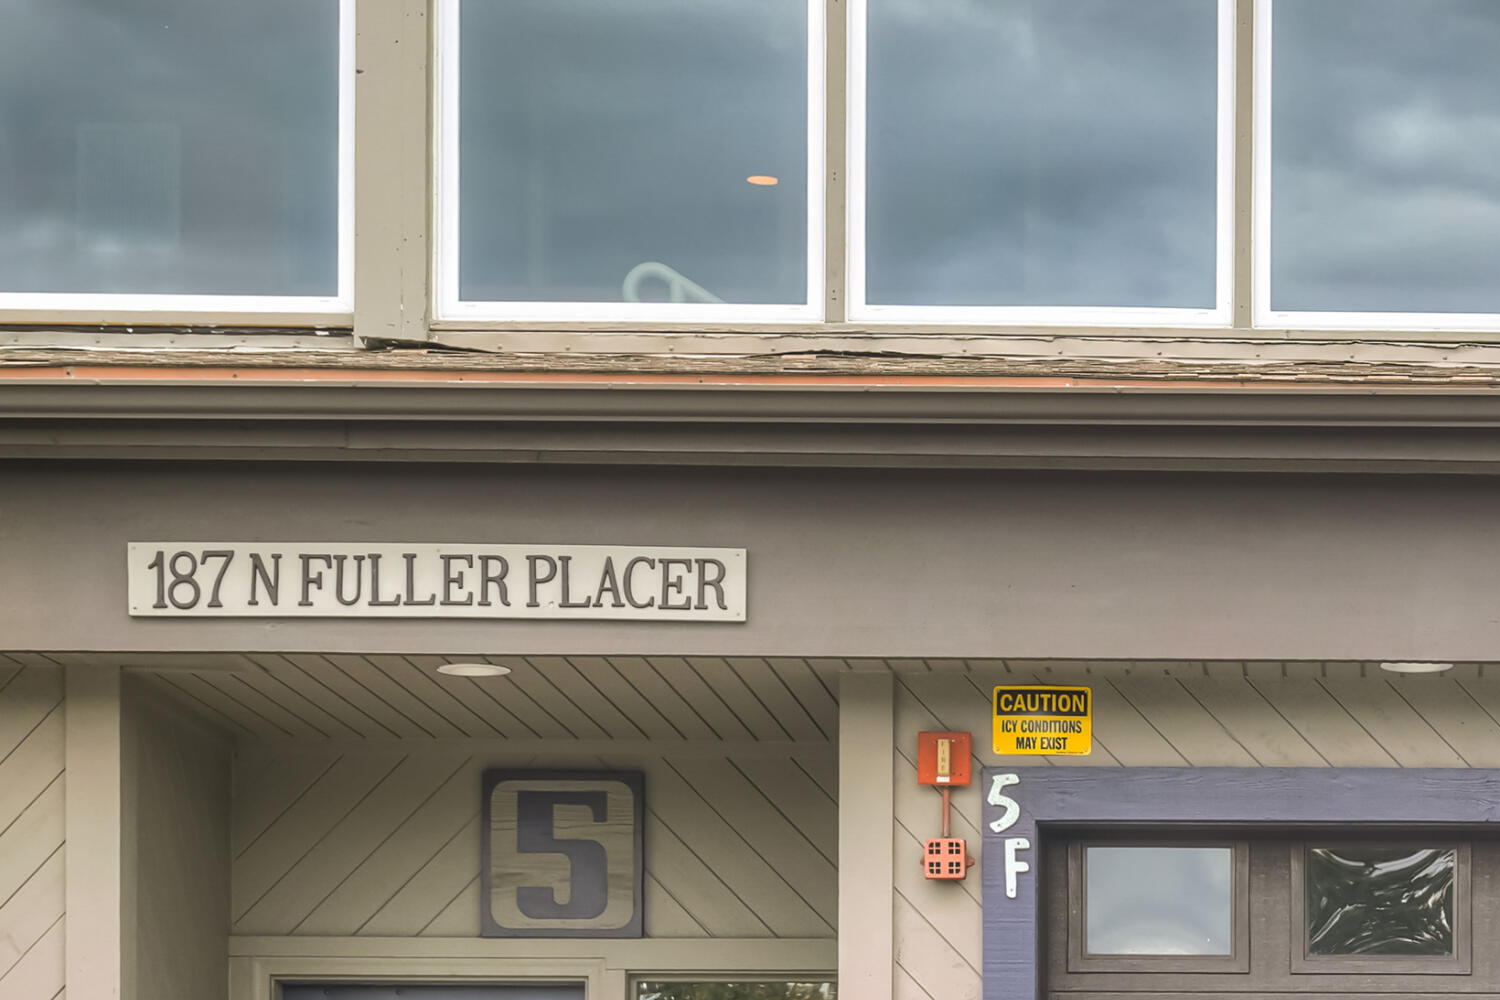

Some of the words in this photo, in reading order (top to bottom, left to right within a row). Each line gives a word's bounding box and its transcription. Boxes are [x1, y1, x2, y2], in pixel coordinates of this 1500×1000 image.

[147, 549, 235, 610] 187
[247, 552, 283, 607] N
[298, 552, 511, 608] FULLER
[525, 553, 728, 611] PLACER
[1000, 693, 1085, 713] CAUTION
[1001, 719, 1018, 733] ICY
[1020, 719, 1082, 734] CONDITIONS
[1016, 736, 1038, 750] MAY
[1040, 736, 1068, 750] EXIST
[516, 790, 608, 919] 5
